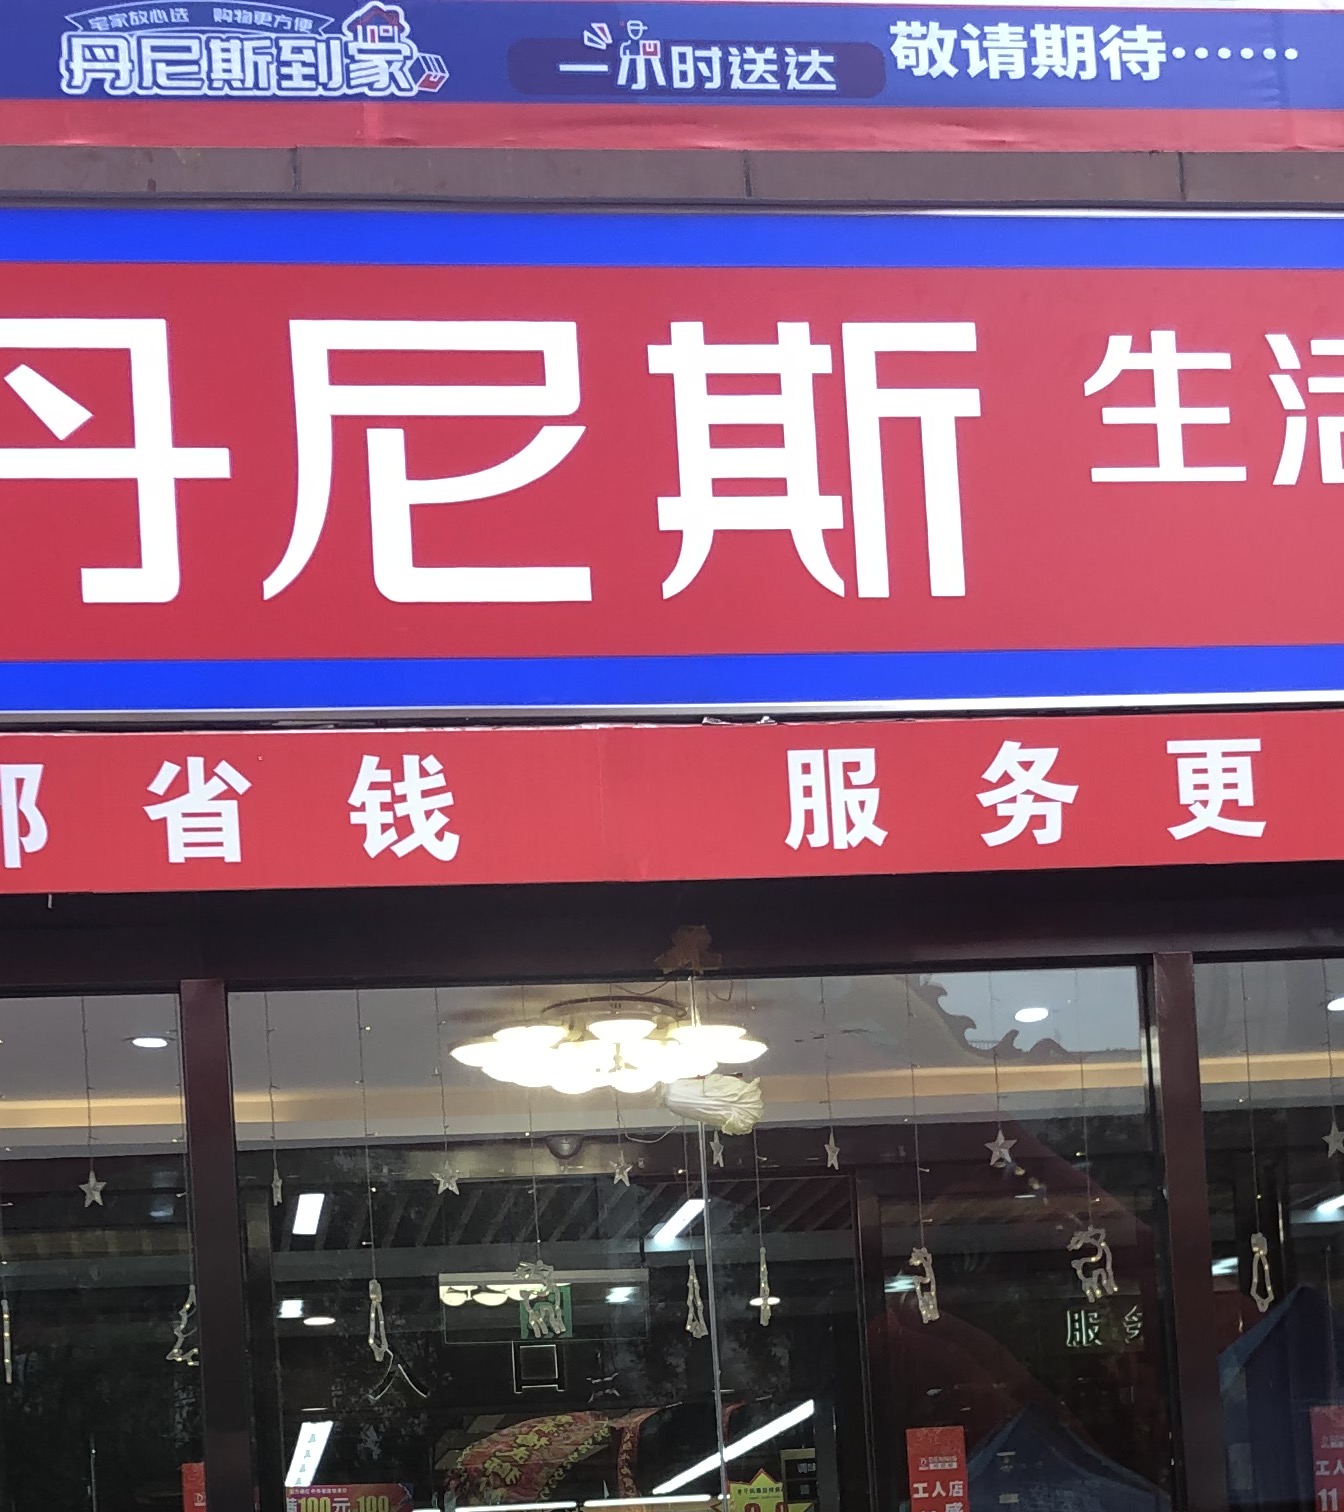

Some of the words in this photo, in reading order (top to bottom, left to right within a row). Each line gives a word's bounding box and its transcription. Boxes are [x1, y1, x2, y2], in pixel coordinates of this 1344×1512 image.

[89, 8, 189, 31] 宅家放心选
[213, 7, 314, 32] 购物更方便
[69, 35, 413, 91] 丹尼斯到家
[558, 44, 837, 91] 一小时送达
[913, 1480, 964, 1498] 工人店
